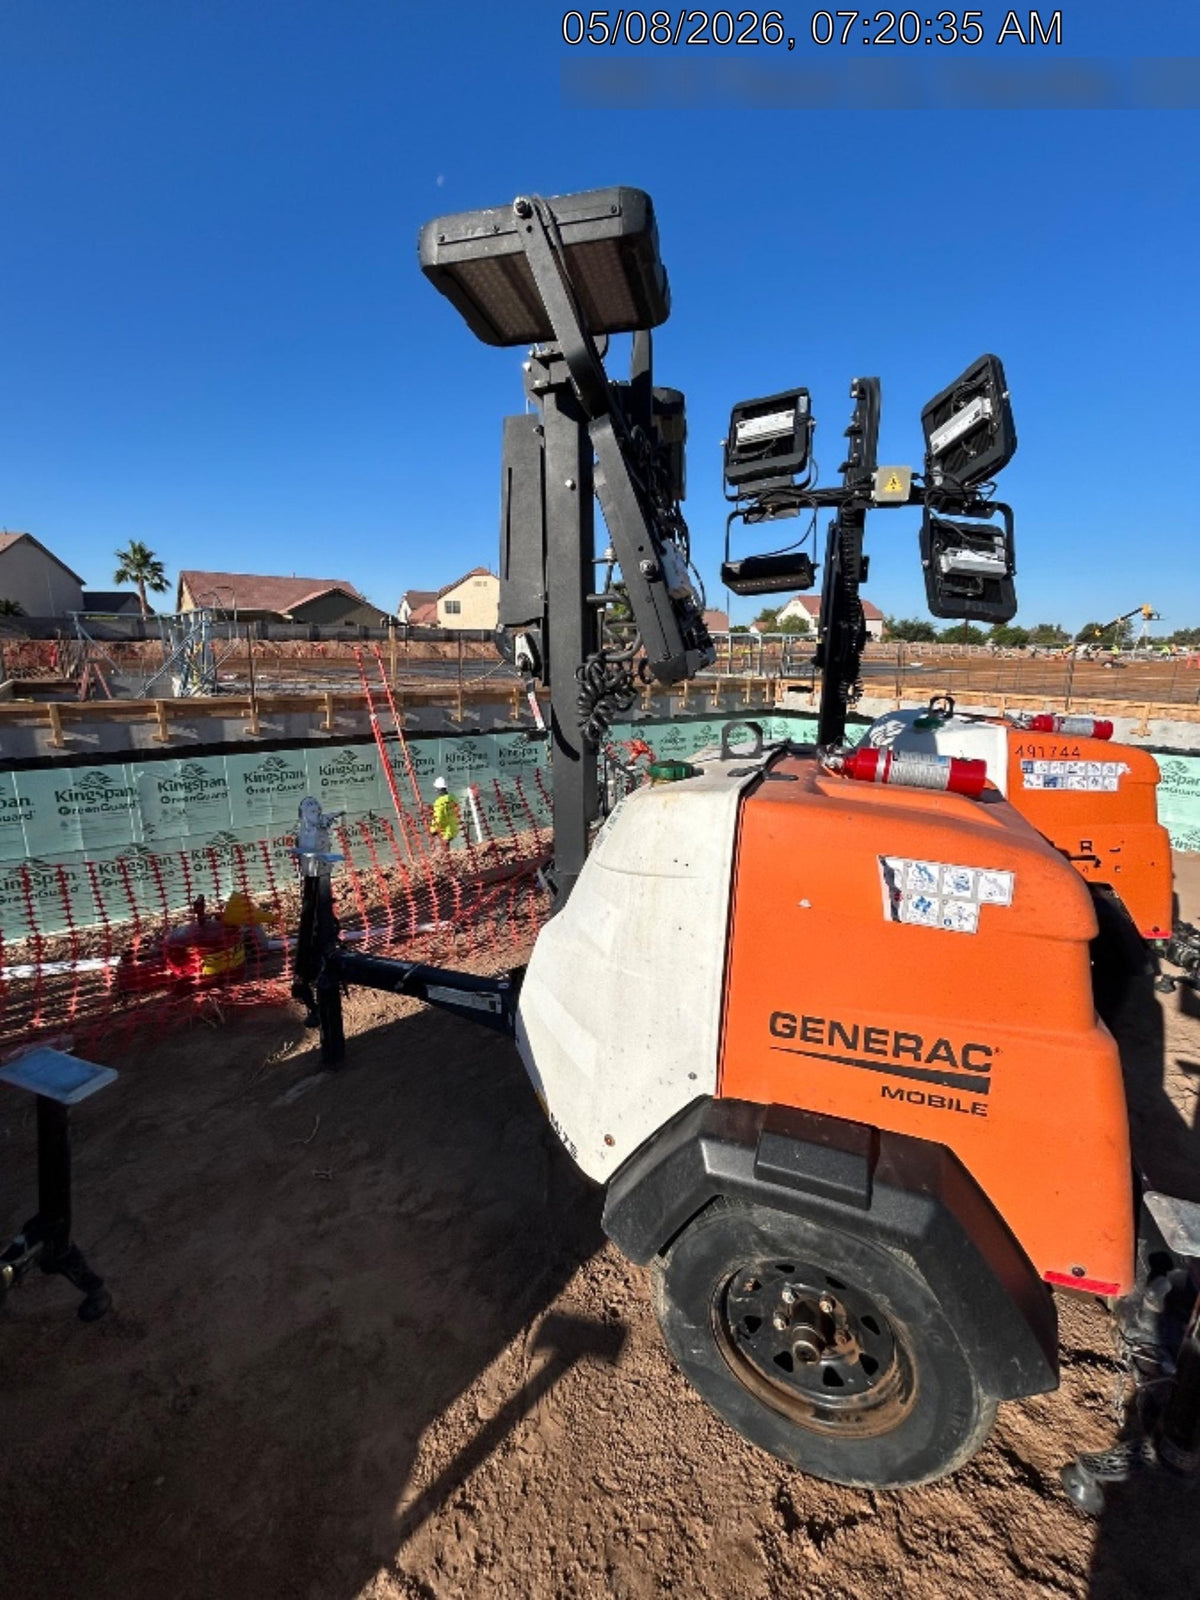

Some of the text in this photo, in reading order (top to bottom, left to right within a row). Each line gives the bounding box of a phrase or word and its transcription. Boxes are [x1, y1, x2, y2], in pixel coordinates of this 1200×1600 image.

[157, 777, 227, 794] Kingspan
[243, 770, 304, 786] Kingspan
[54, 786, 138, 804] Kingspan
[769, 1011, 993, 1073] GENERAC
[881, 1085, 989, 1108] MOBILE
